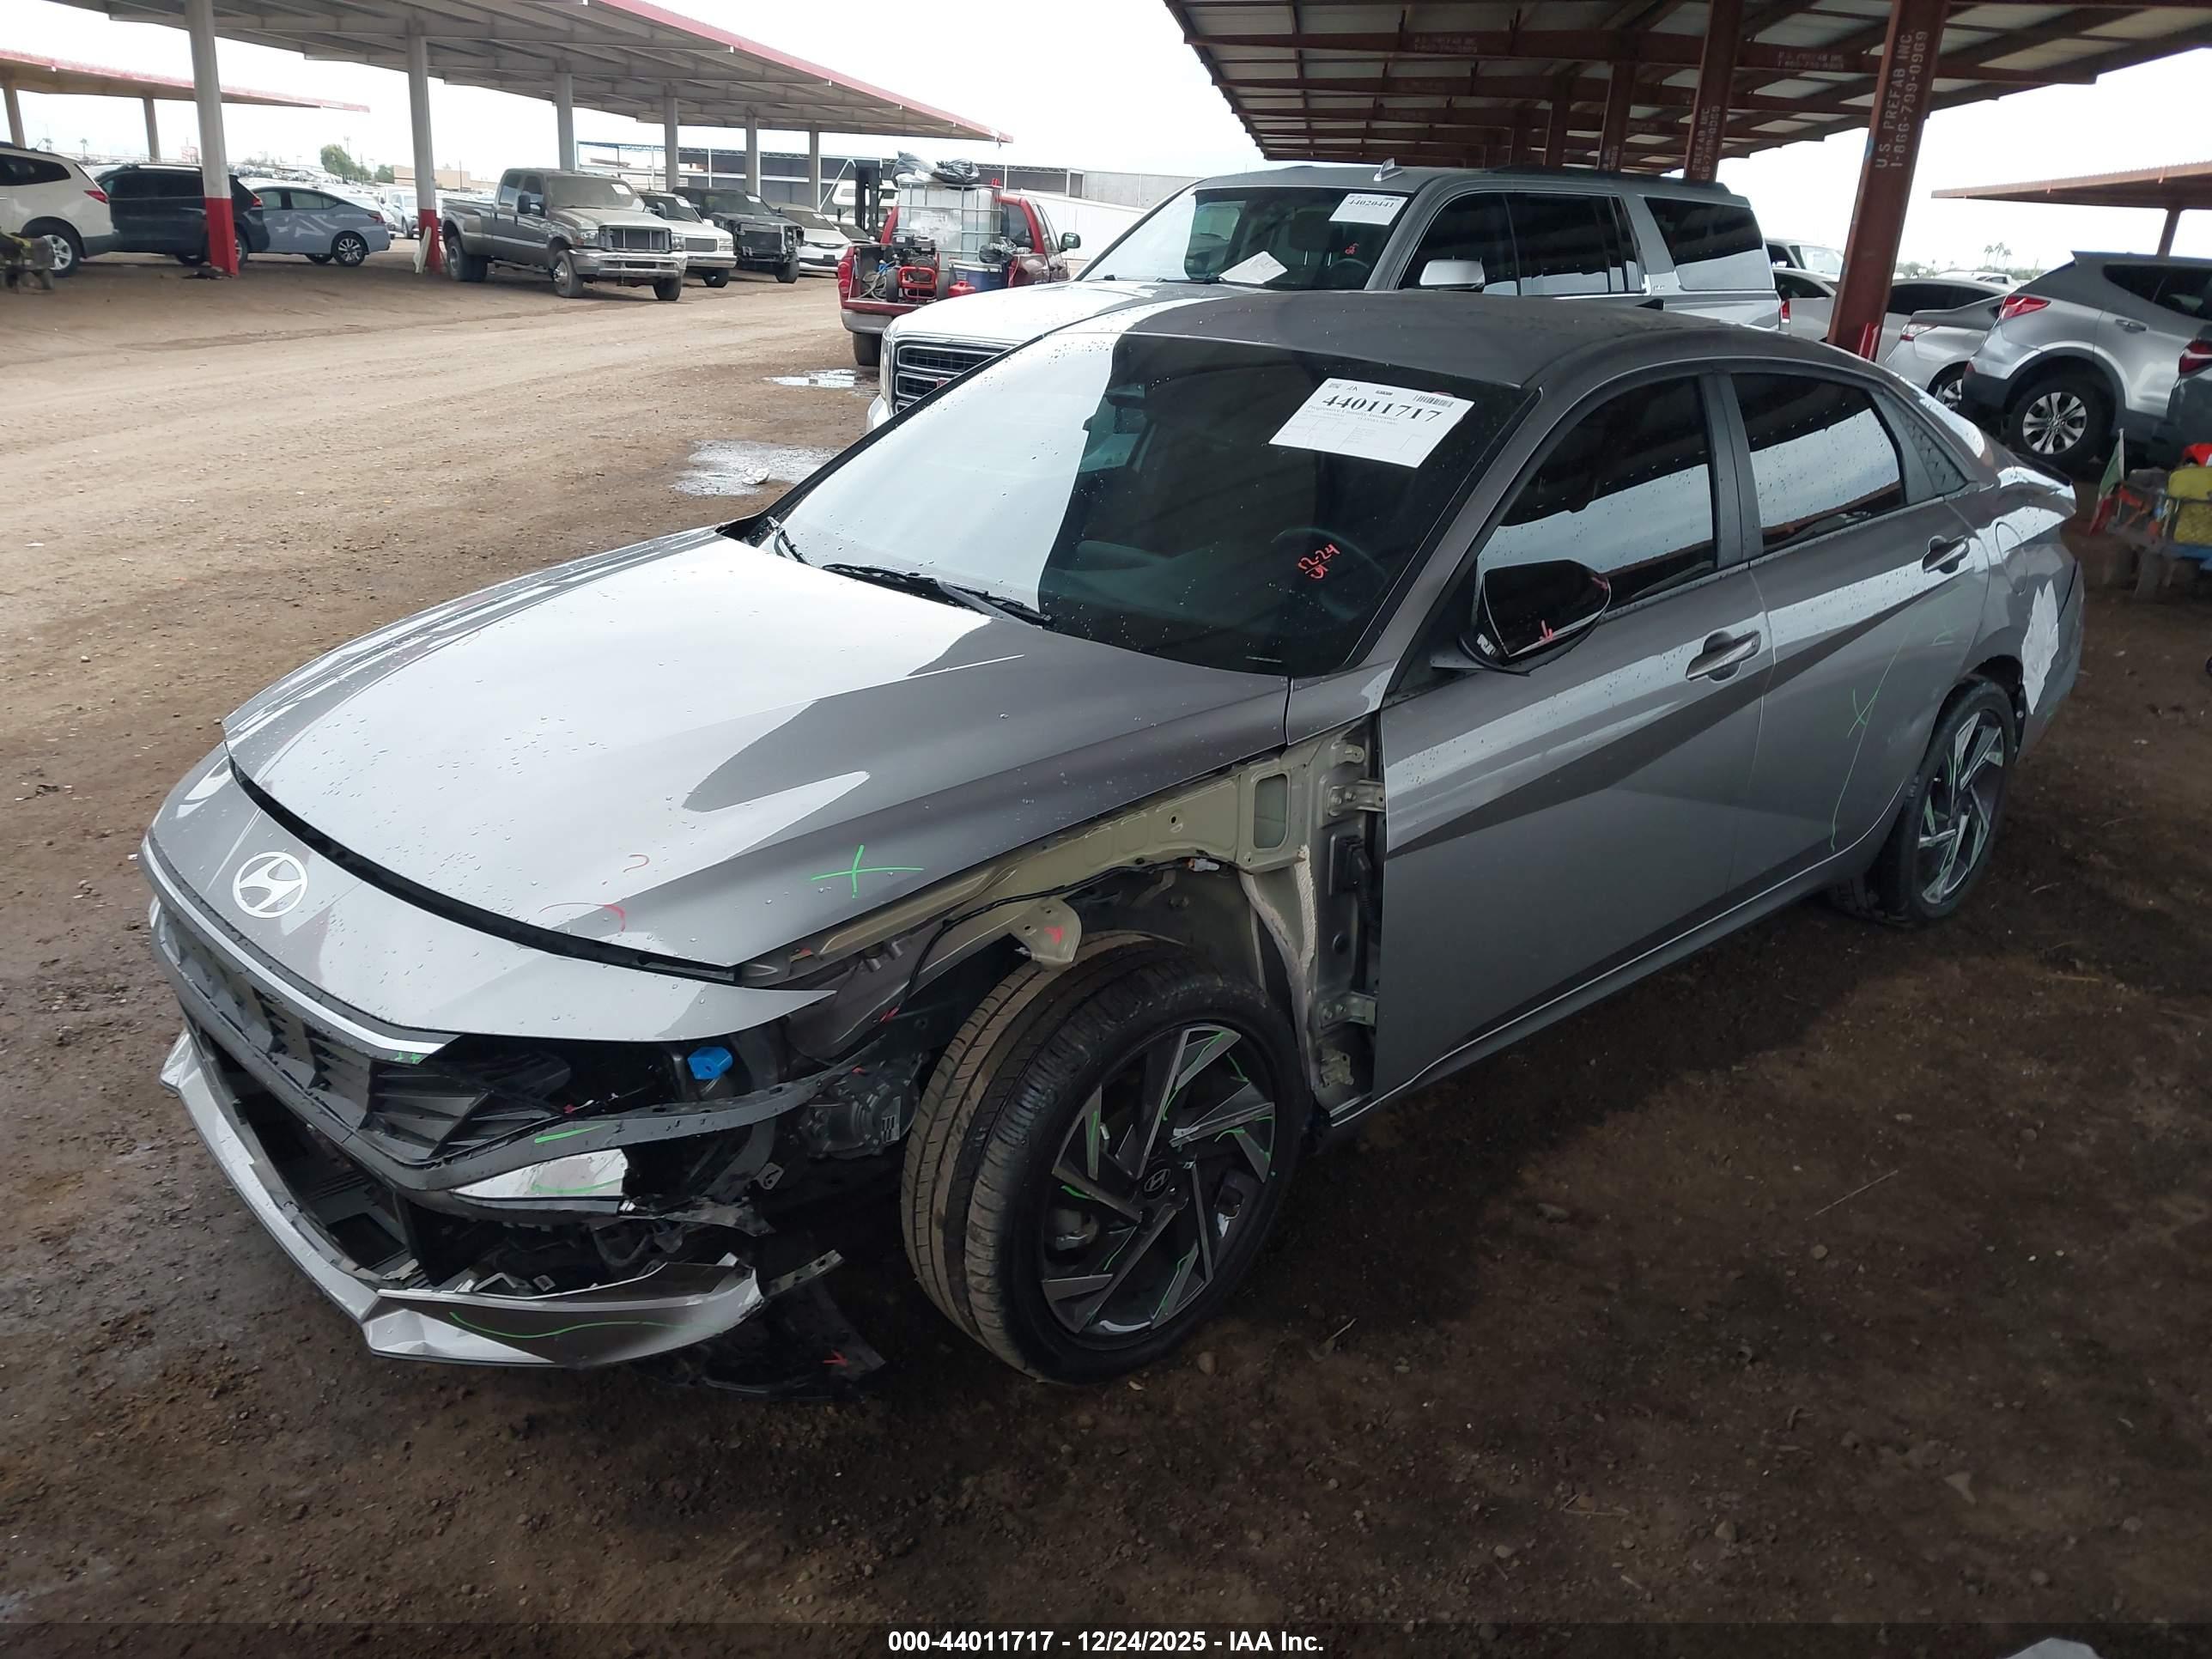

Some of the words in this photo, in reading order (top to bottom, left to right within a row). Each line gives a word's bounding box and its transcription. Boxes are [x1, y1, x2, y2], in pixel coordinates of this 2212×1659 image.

[1883, 68, 1905, 130] PREFAB
[1890, 31, 1929, 167] 1-866-799-0969
[1322, 394, 1443, 422] 44011717
